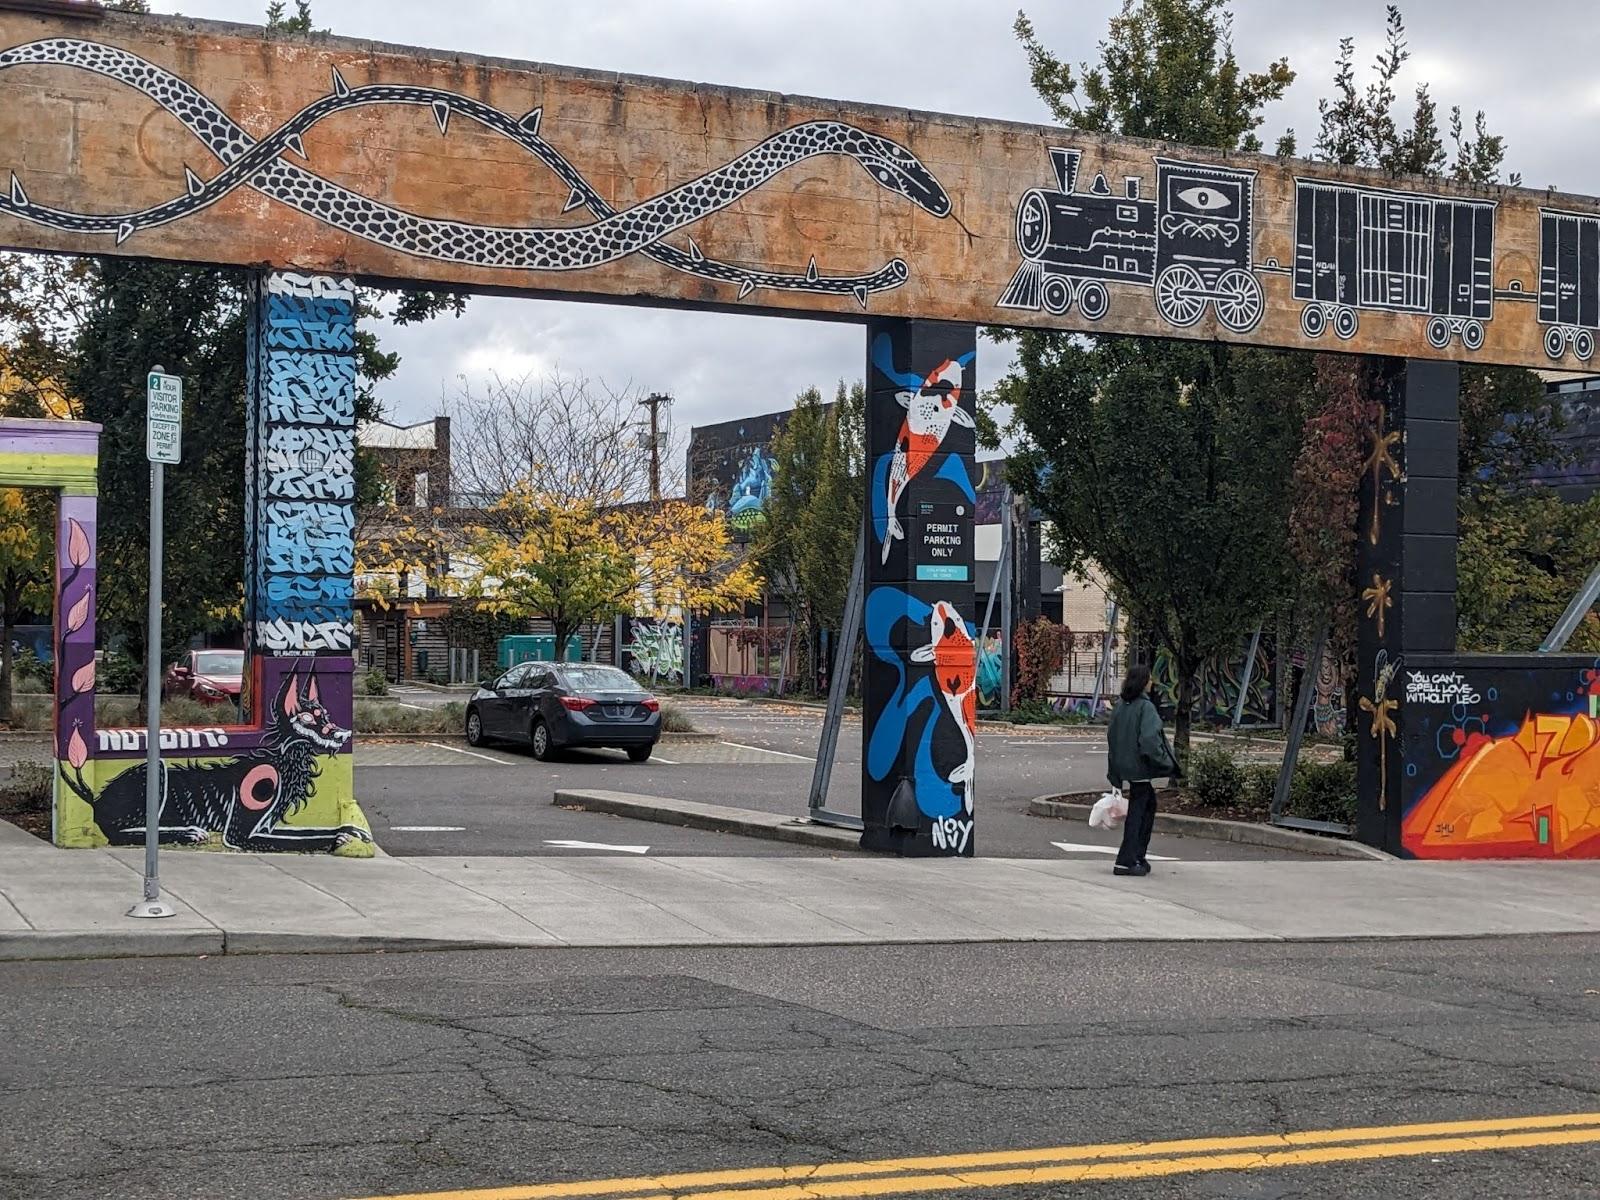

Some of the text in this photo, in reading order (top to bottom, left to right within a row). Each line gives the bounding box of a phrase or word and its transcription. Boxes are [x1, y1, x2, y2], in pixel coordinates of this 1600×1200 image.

[153, 378, 158, 389] 2
[153, 392, 177, 403] VISITOR
[151, 402, 178, 413] PARKING
[153, 422, 177, 432] EXCEPT BY
[153, 431, 170, 441] ZONE
[156, 442, 173, 450] PERMIT
[926, 523, 959, 533] PERMIT
[923, 535, 961, 545] PARKING
[931, 548, 953, 557] ONLY
[1406, 670, 1464, 684] YOU CAN'T
[1406, 683, 1473, 694] SPELL LOVE
[1406, 692, 1481, 704] WITHOUT LEO
